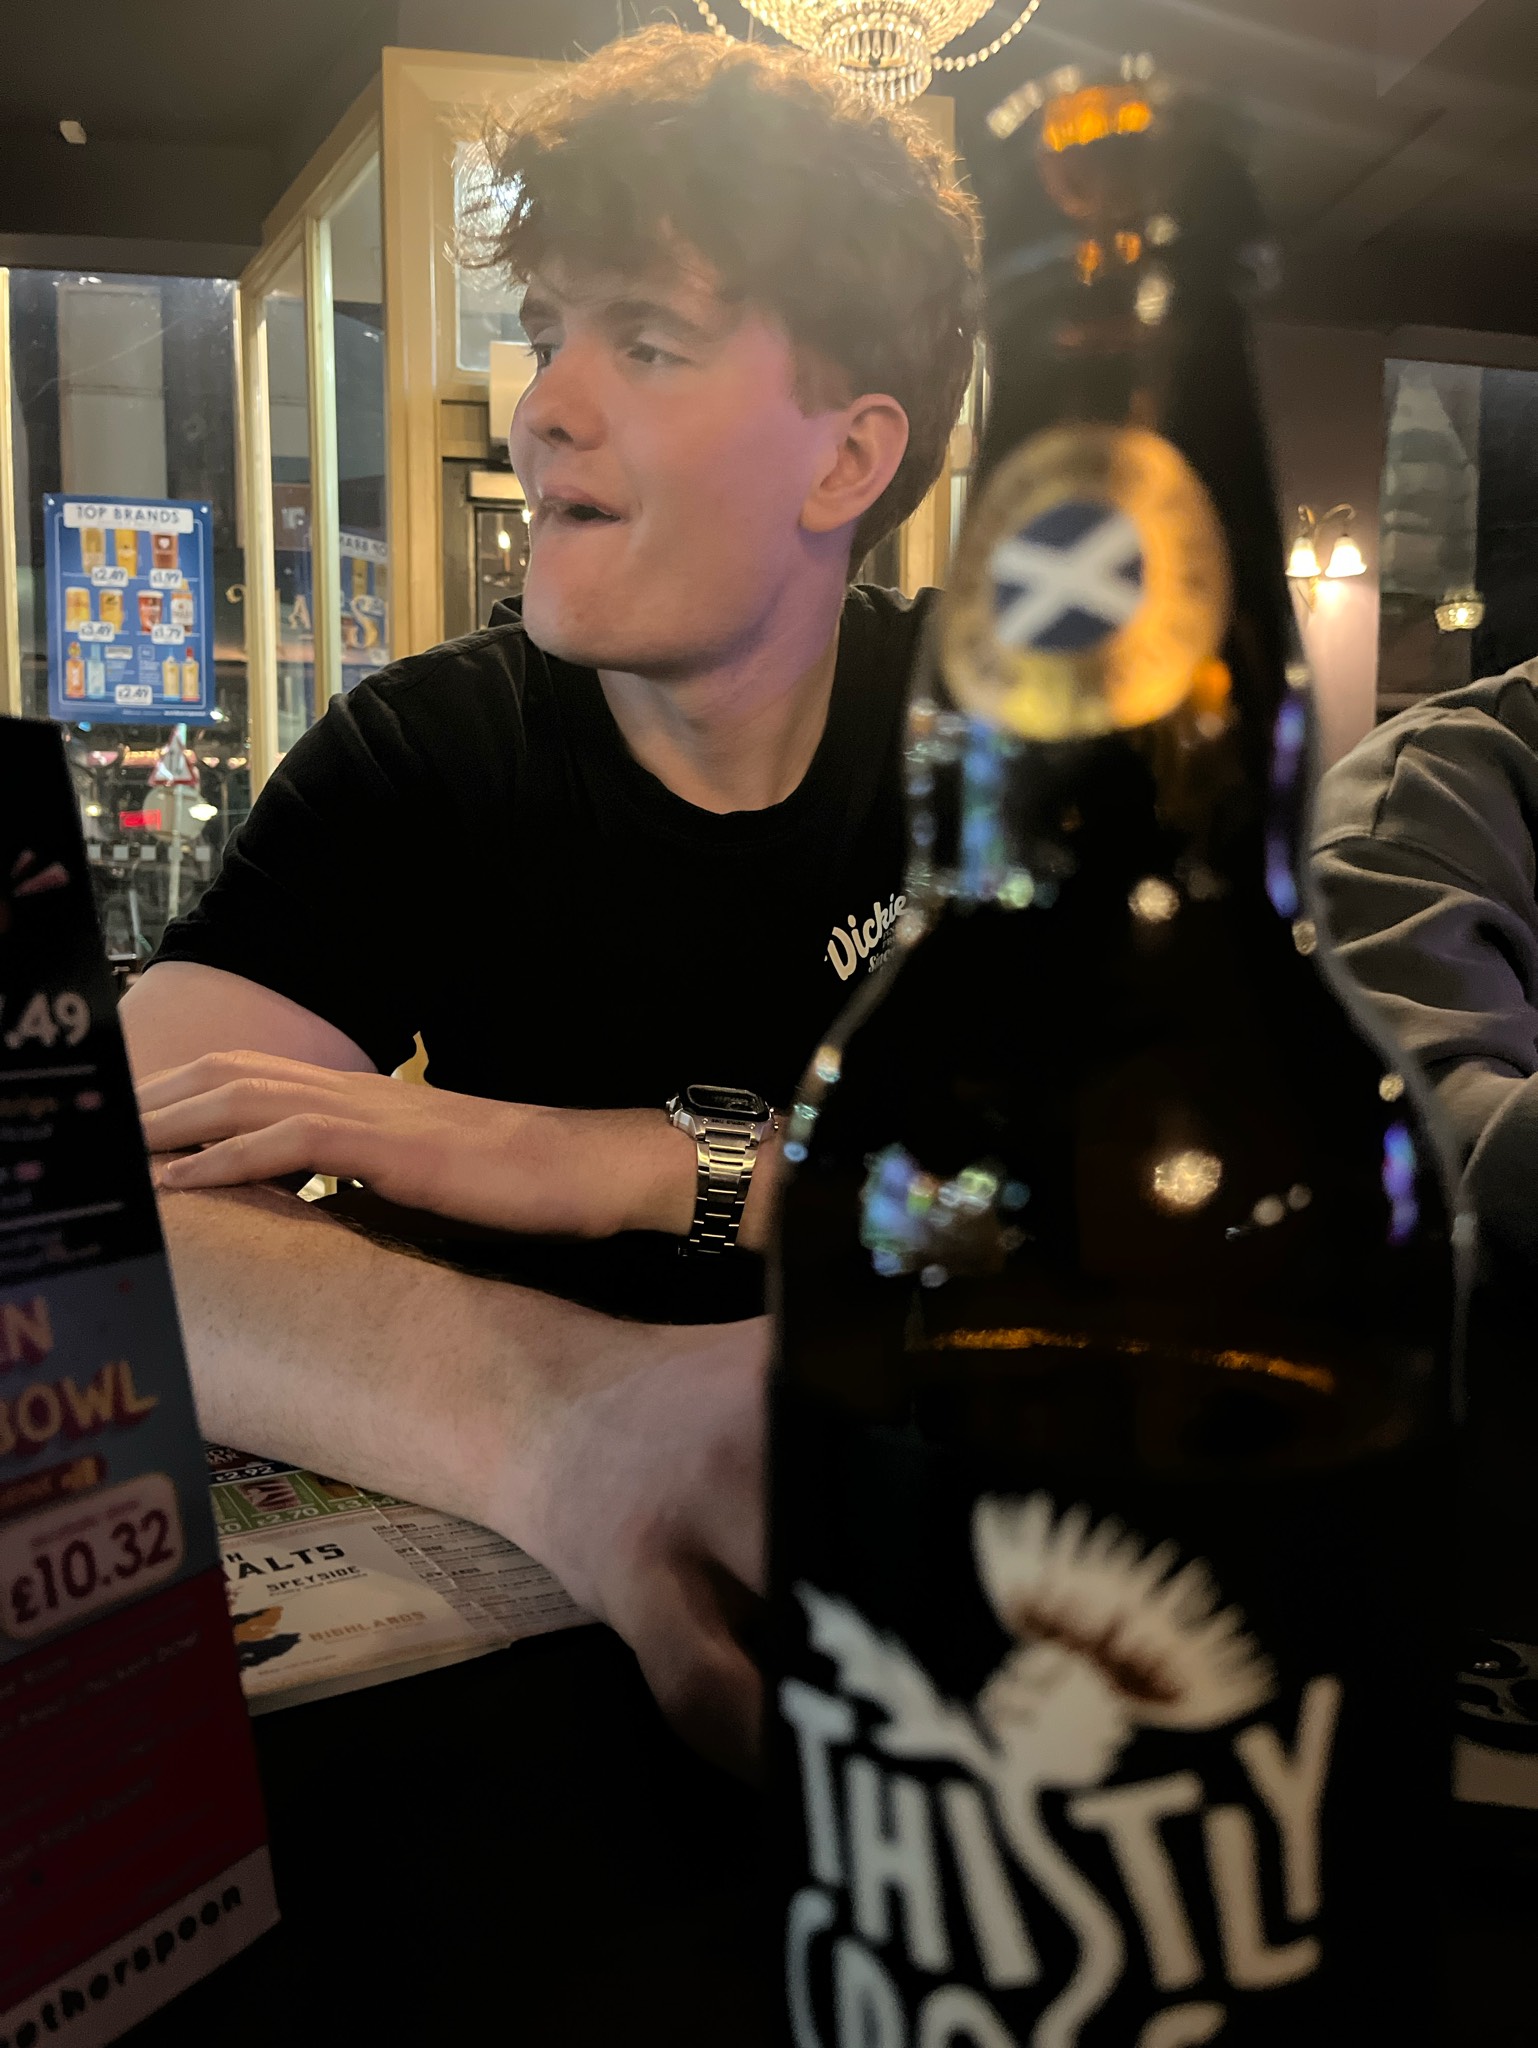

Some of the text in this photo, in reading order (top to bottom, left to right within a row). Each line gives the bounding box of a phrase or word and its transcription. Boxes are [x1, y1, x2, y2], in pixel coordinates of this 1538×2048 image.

[77, 506, 179, 523] TOP BRANDS
[827, 893, 912, 981] Dickie
[0, 991, 92, 1050] .49
[257, 1507, 318, 1527] £2.70
[10, 1510, 174, 1623] £10.32
[239, 1544, 345, 1580] ALTS
[266, 1565, 361, 1592] SPEYSIDE
[309, 1611, 426, 1642] HIGHLANDS
[780, 1675, 1343, 2030] THISTLY
[0, 1886, 242, 2048] etherspoon
